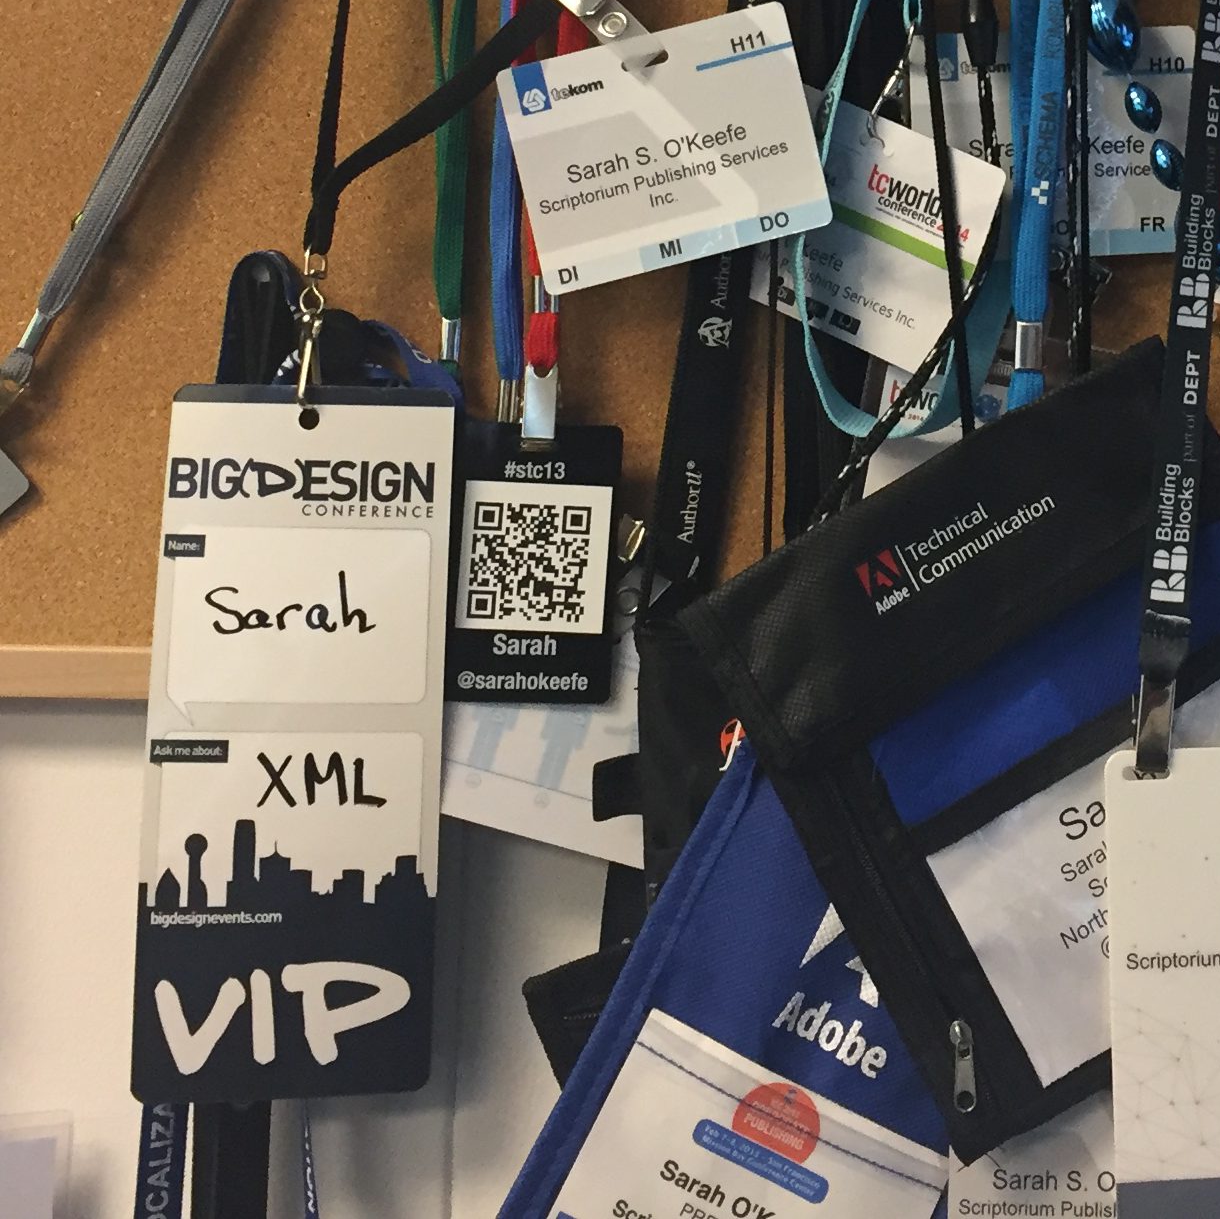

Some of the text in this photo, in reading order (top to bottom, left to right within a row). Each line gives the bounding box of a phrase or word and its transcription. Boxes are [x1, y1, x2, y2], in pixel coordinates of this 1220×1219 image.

[730, 32, 766, 53] H11
[1150, 58, 1185, 74] H10
[551, 80, 604, 101] tekom
[1205, 85, 1220, 138] DEPT
[567, 125, 747, 184] Sarah S. O'Keefe
[1094, 162, 1151, 178] Service
[539, 141, 789, 215] Scriptorium Publishing Services
[649, 192, 679, 208] Inc.
[878, 195, 936, 228] conference
[1140, 217, 1165, 232] FR
[1182, 193, 1205, 269] Building
[1197, 207, 1216, 272] Blocks
[558, 212, 790, 285] DI MI DO
[843, 285, 893, 319] Services
[896, 310, 916, 329] Inc.
[1183, 350, 1202, 406] DEPT
[504, 461, 566, 479] #stc13
[302, 504, 434, 518] CONFERENCE
[1155, 463, 1182, 542] Building
[1174, 476, 1195, 544] Blocks
[905, 502, 989, 562] Technical
[918, 495, 1056, 584] Communication
[205, 570, 376, 634] Sarah
[874, 586, 911, 616] Adobe
[492, 634, 557, 656] Sarah
[457, 671, 589, 691] @sarahokeefe
[153, 744, 174, 757] Ask
[175, 746, 190, 756] me
[257, 751, 387, 808] XML
[150, 911, 282, 928] bigdesignevents.com
[154, 961, 411, 1076] VIP
[772, 991, 888, 1080] Adobe
[744, 1113, 805, 1150] PUBLISHING
[659, 1159, 726, 1208] Sarah
[992, 1170, 1058, 1191] Sarah
[1066, 1170, 1089, 1192] S.
[958, 1199, 1055, 1219] Scriptorium
